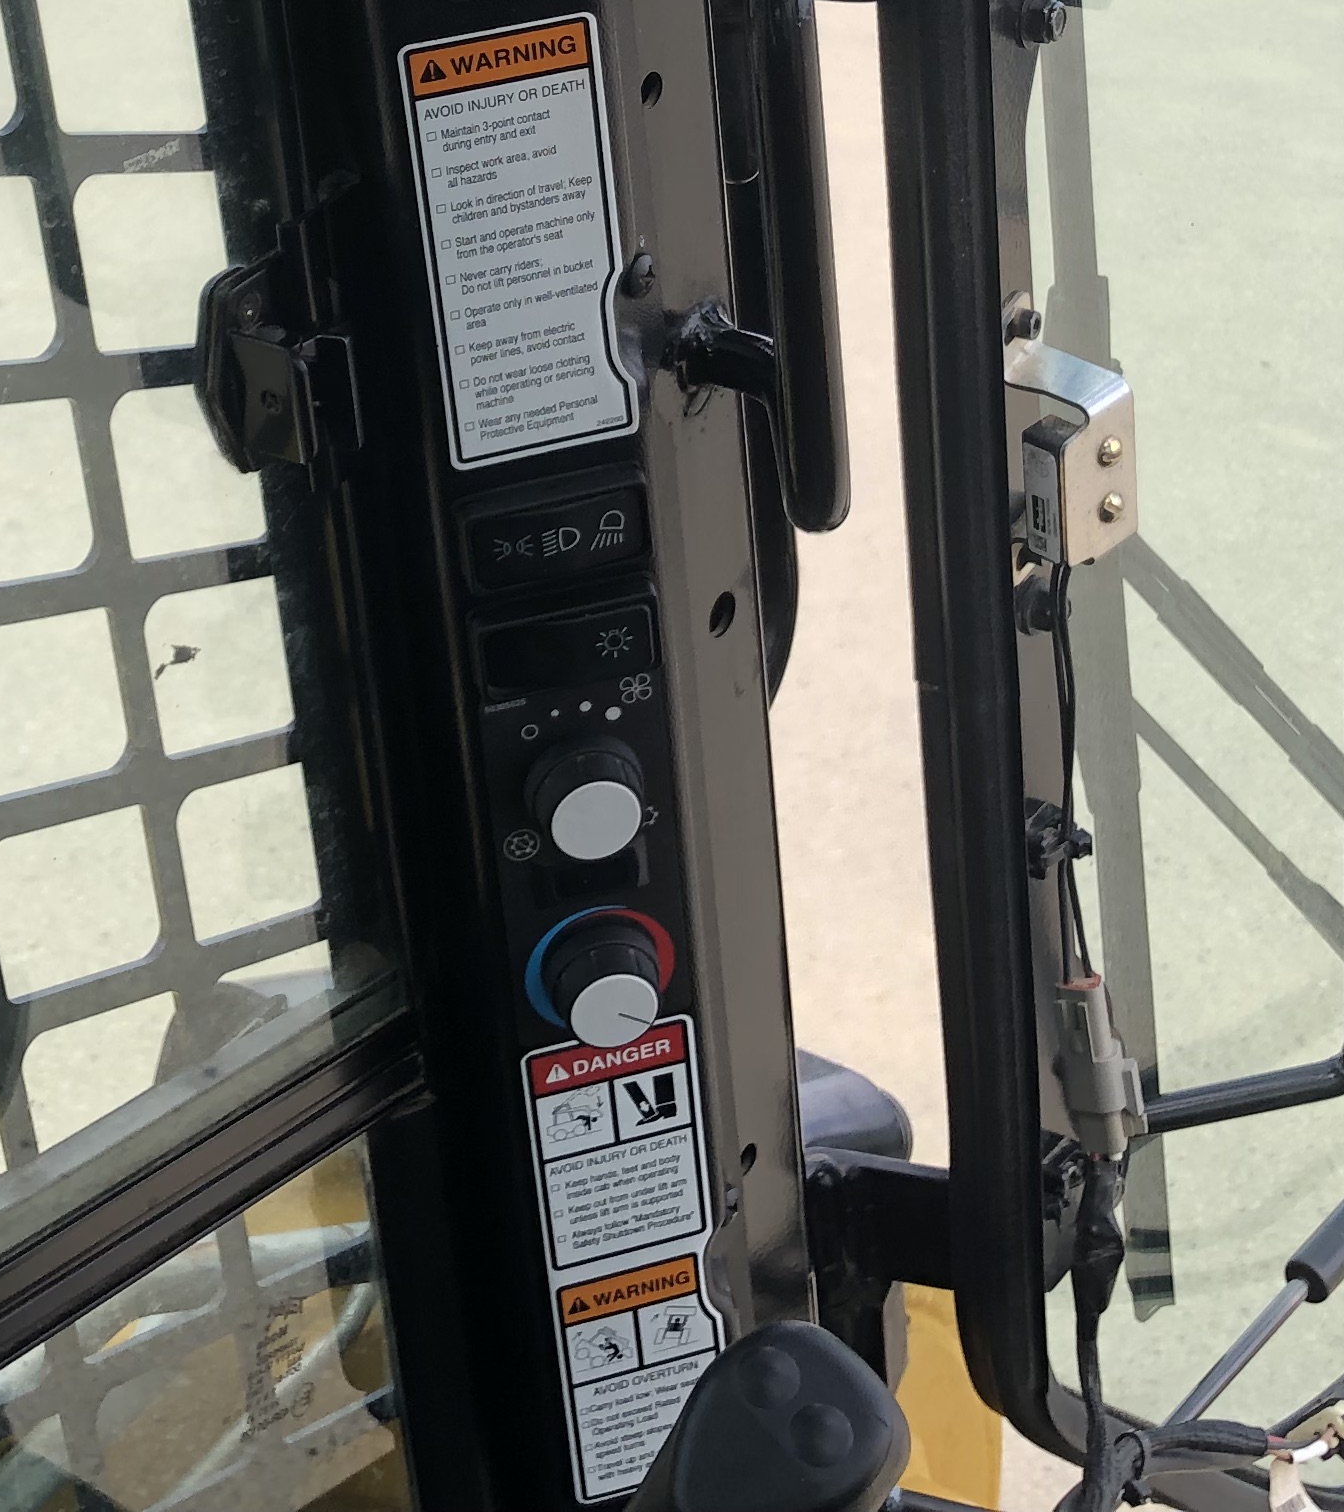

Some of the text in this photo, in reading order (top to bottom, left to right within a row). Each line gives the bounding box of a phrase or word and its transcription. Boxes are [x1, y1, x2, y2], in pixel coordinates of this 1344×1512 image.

[450, 35, 577, 76] WARNING
[424, 79, 585, 120] AVOID INJURY OR DEATH
[441, 109, 550, 139] Maintain 3-point contact
[443, 125, 536, 152] during entry and exit
[446, 161, 479, 175] Inspect
[481, 156, 503, 168] work
[532, 145, 556, 158] avoid
[448, 171, 497, 188] all hazards
[451, 199, 473, 211] Look
[475, 197, 484, 206] in
[486, 190, 524, 204] direction
[527, 185, 536, 196] of
[568, 176, 592, 187] Keep
[452, 190, 585, 224] children and bystanders away
[455, 211, 595, 247] Start and operate machine only
[457, 229, 563, 259] from the operator's seat
[460, 270, 486, 282] Never
[490, 265, 511, 276] carry
[462, 259, 593, 295] Do not lift personnel in bucket
[465, 281, 598, 318] Operate only in well-ventilated
[467, 319, 486, 330] area
[469, 322, 575, 352] Keep away from electric
[471, 352, 497, 367] power
[527, 339, 550, 352] avoid
[553, 332, 585, 347] contact
[473, 355, 590, 387] Do not wear loose clothing
[475, 366, 594, 398] while operating or servicing
[477, 395, 514, 410] machine
[478, 395, 598, 428] Wear any needed Personal
[480, 412, 574, 440] Protective Equipment
[572, 1038, 671, 1077] DANGER
[550, 1135, 687, 1177] AVOID INJURY OR DEATH
[593, 1270, 690, 1307] WARNING
[593, 1361, 698, 1396] AVOID OVERTURN
